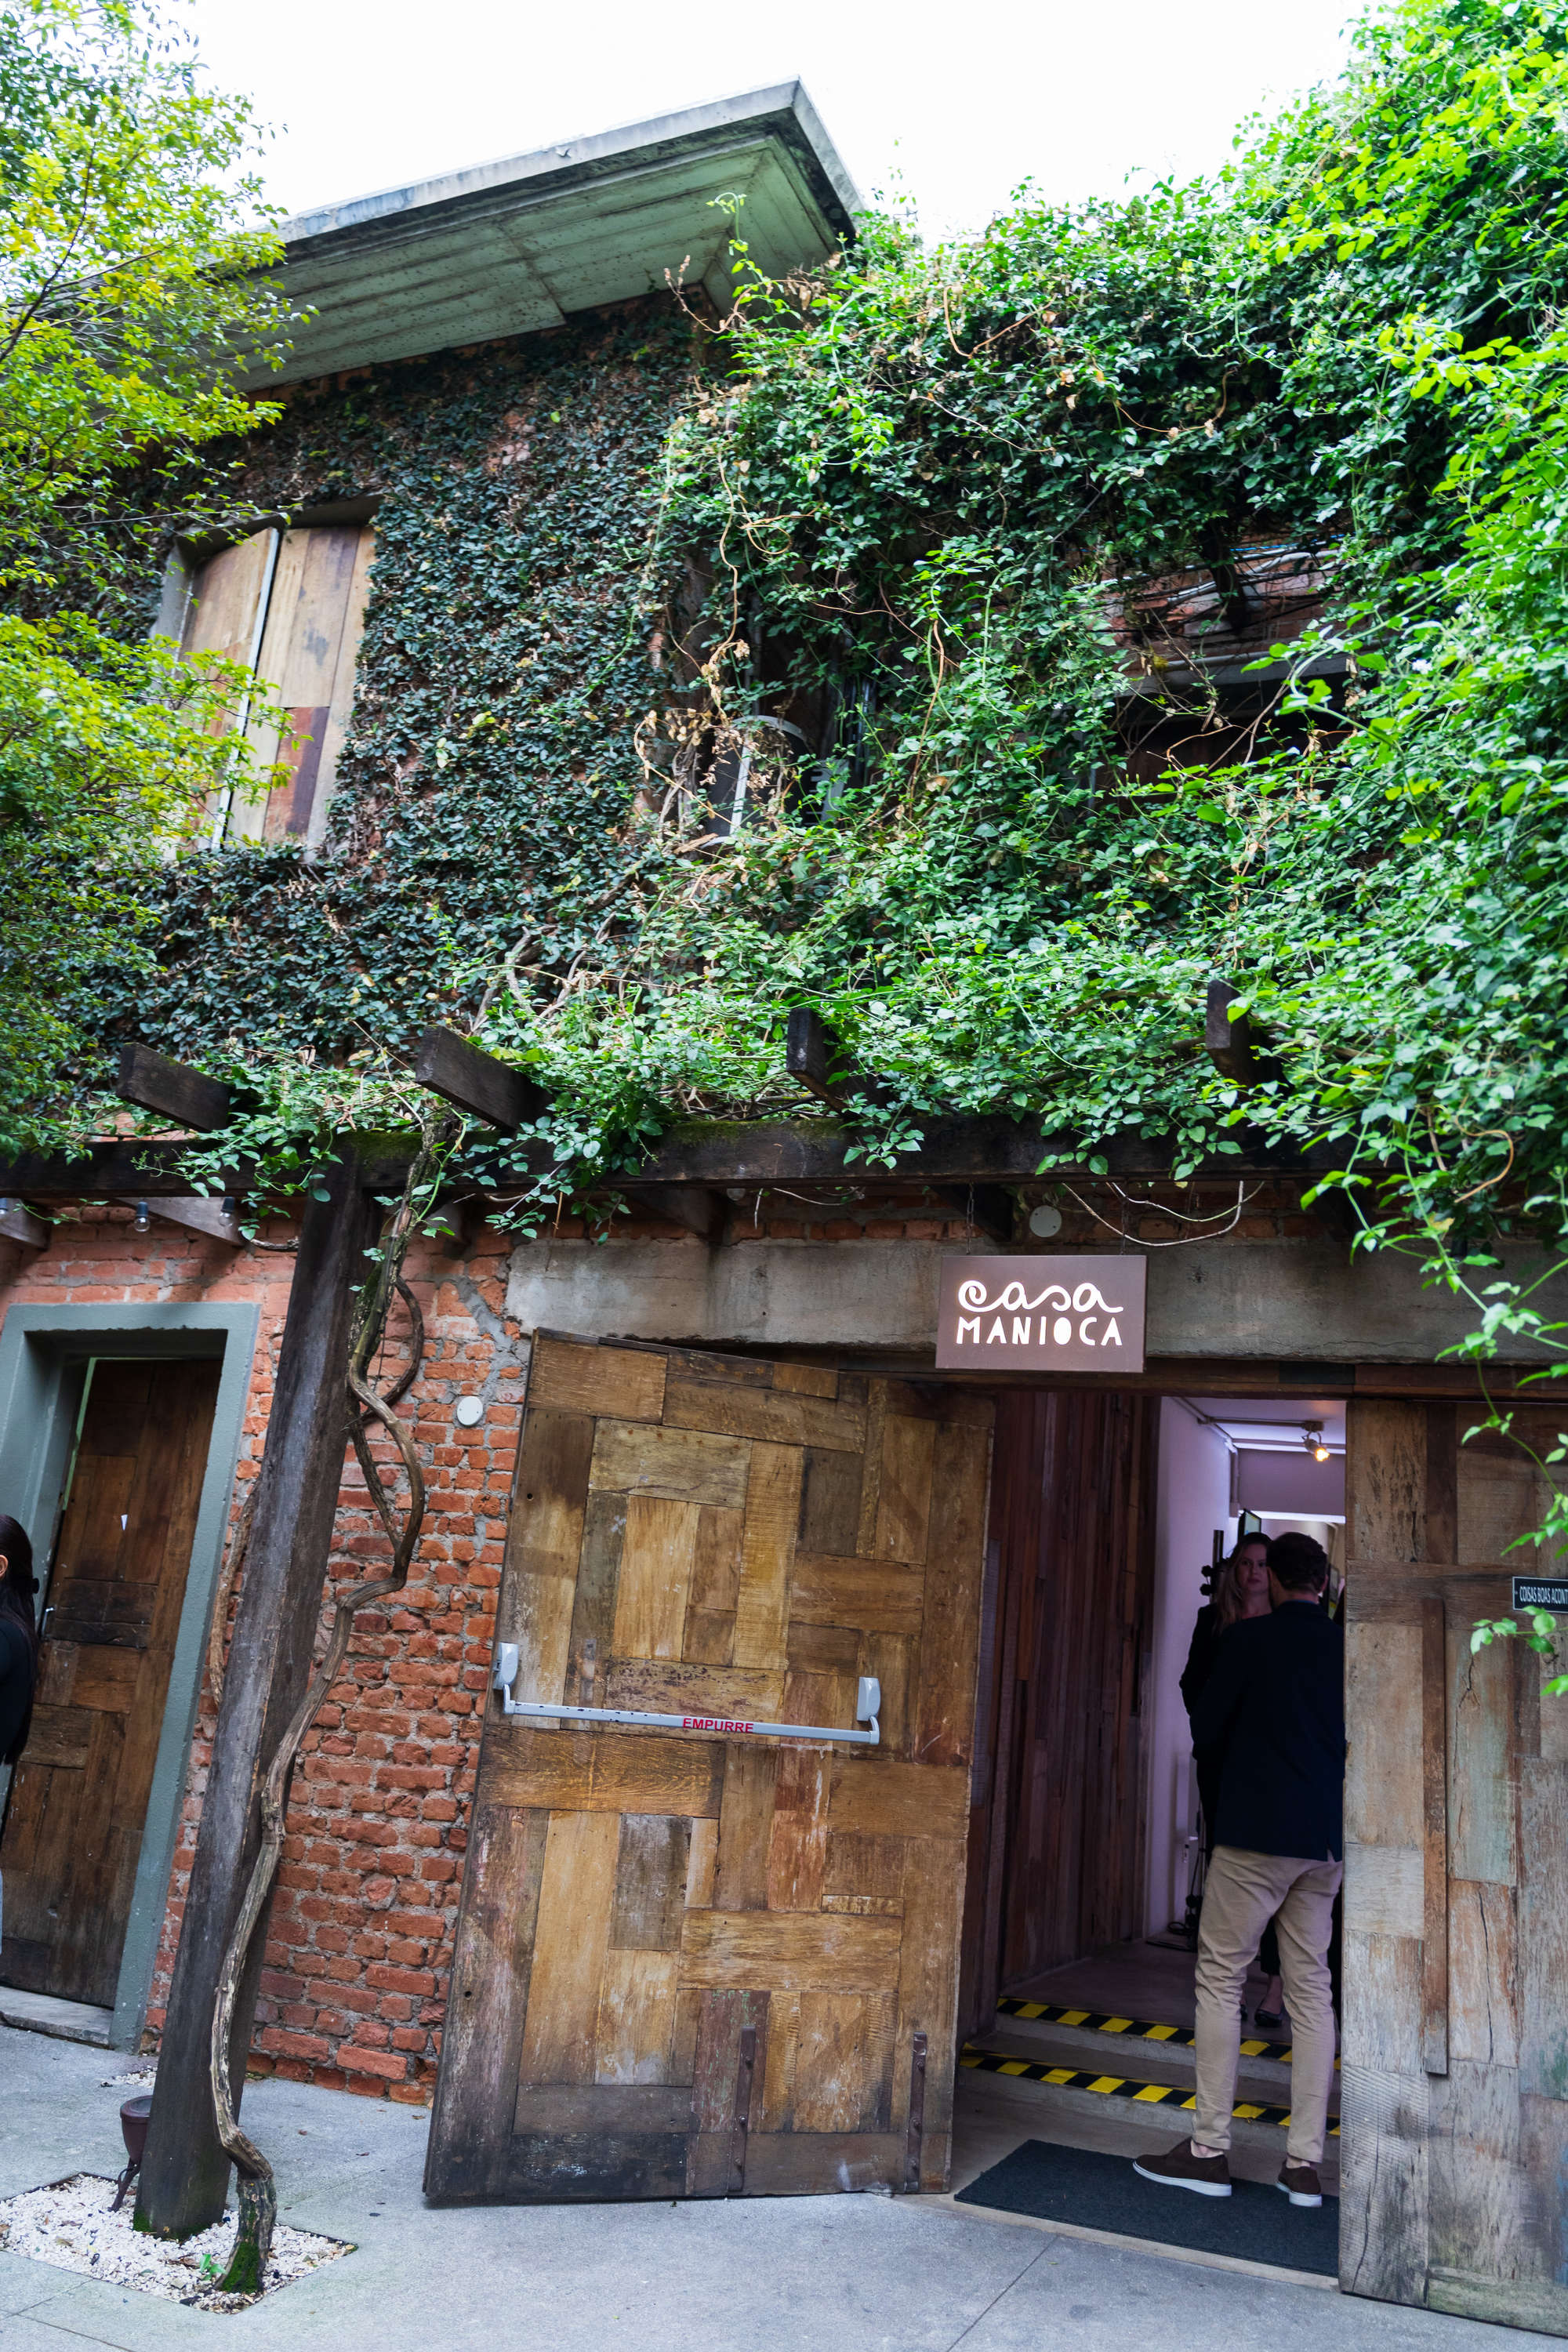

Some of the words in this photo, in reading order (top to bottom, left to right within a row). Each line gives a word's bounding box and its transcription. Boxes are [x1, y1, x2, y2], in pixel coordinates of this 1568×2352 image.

[956, 1316, 1123, 1346] MANIOCA
[1519, 1586, 1537, 1602] COISAS
[1537, 1587, 1551, 1603] BOAS
[682, 1718, 754, 1733] EMPURRE
